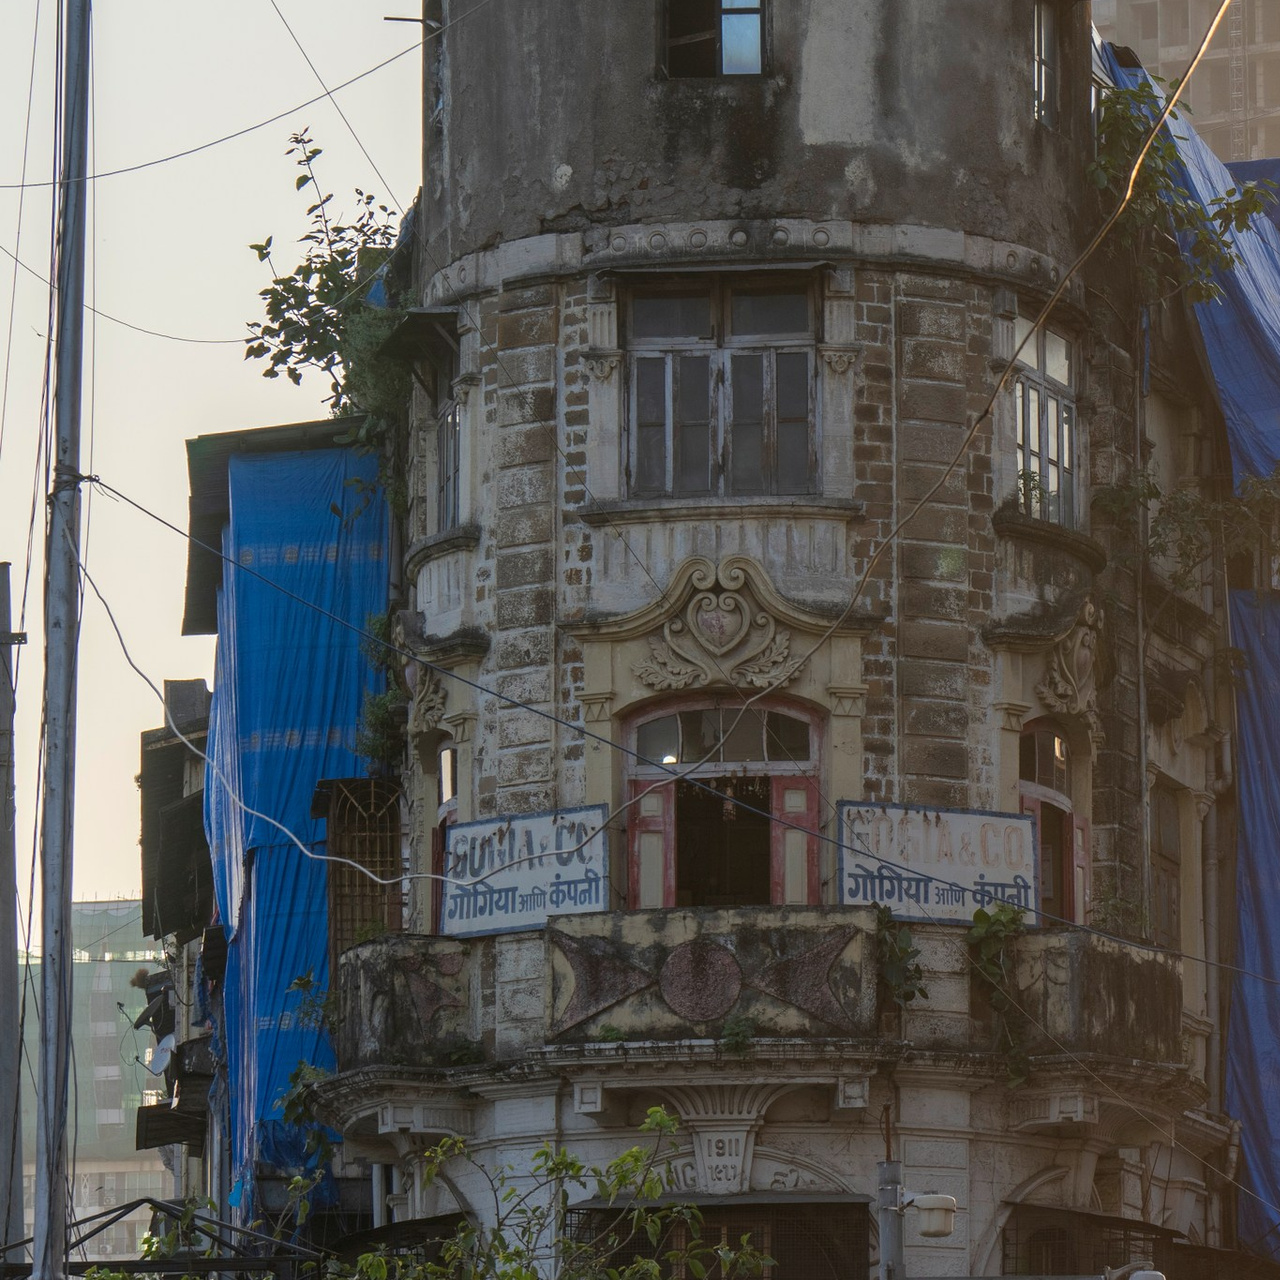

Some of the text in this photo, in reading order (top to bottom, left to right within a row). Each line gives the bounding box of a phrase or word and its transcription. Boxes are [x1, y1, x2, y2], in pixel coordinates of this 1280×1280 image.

[519, 886, 548, 913] आणि
[550, 869, 601, 908] कंपनी
[848, 864, 933, 905] गोगिया
[935, 881, 967, 907] आणि
